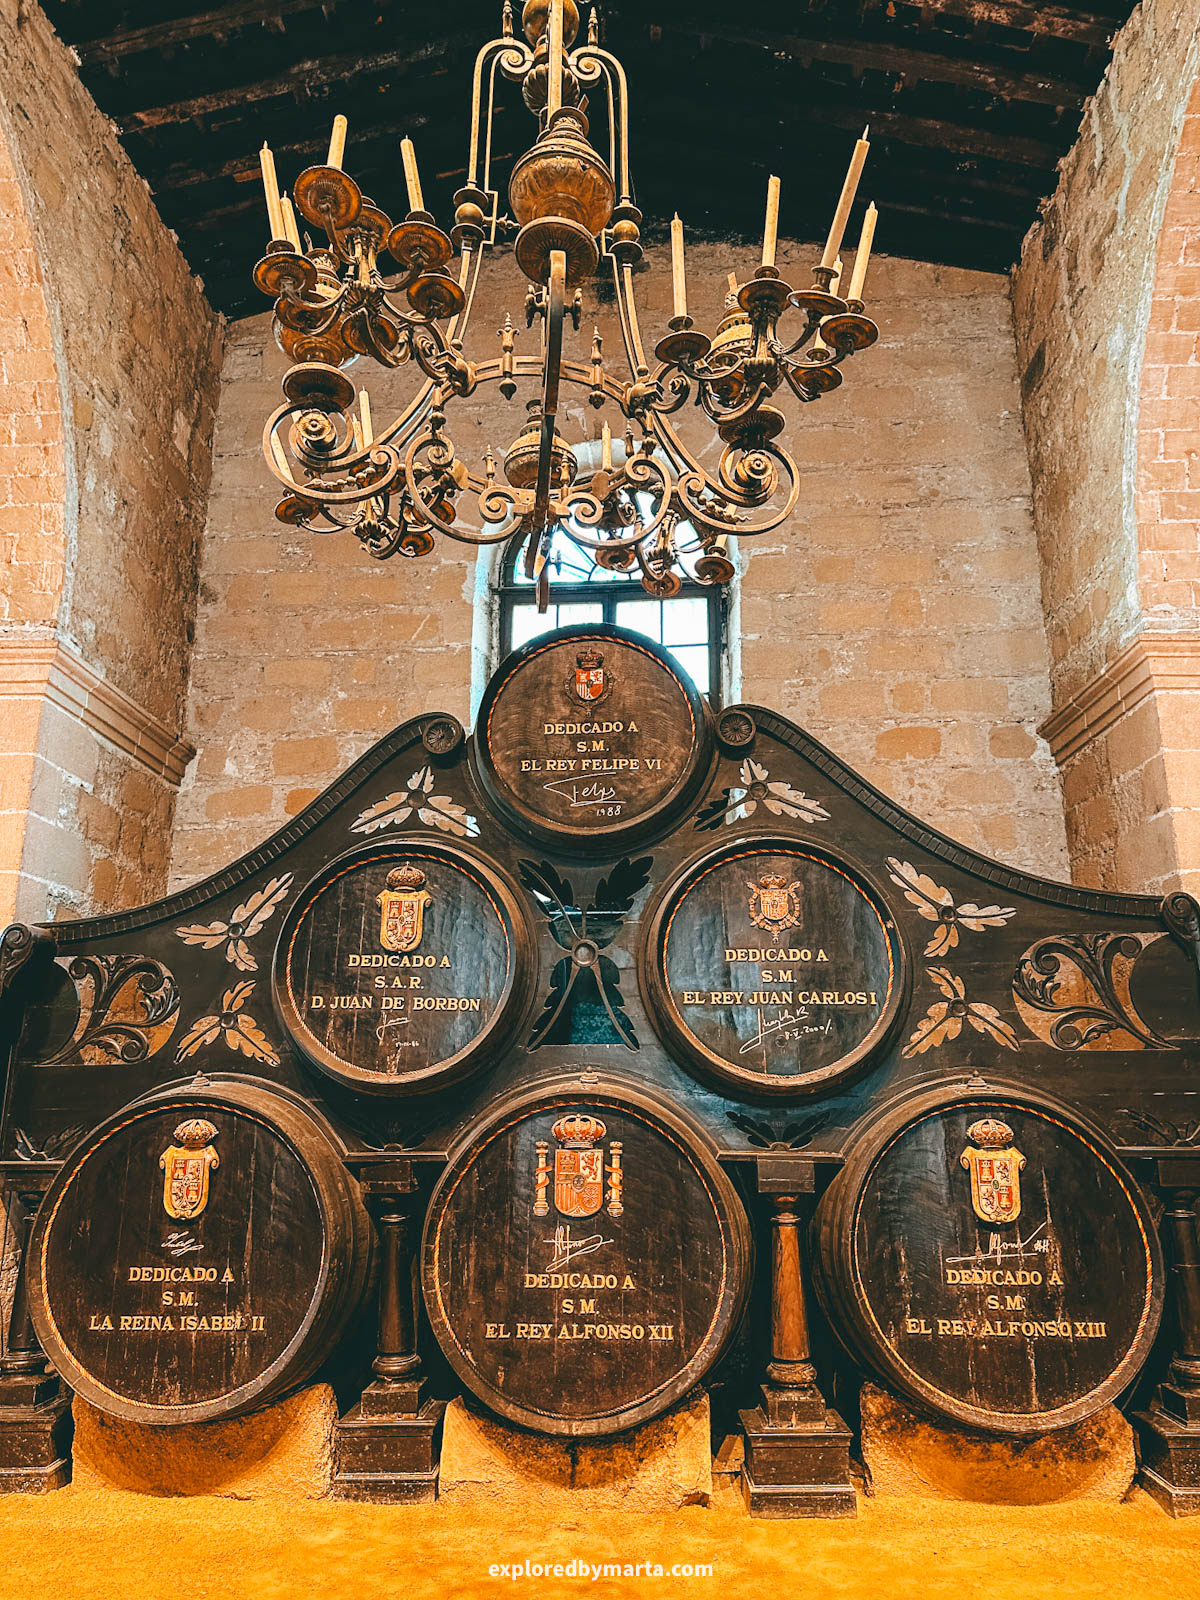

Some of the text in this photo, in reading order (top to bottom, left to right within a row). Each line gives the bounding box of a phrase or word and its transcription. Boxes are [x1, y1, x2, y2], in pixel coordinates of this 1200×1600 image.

[543, 721, 639, 735] DEDICADO A
[576, 740, 610, 753] S.M.
[521, 759, 662, 772] EL REY FELIPE VI
[348, 954, 451, 968] DEDICADO A
[724, 949, 829, 963] DEDICADO A
[761, 970, 797, 983] S.M.
[311, 996, 481, 1011] D. JUAN DE BORBON
[682, 992, 705, 1005] EL
[710, 992, 744, 1005] REY
[748, 992, 793, 1005] JUAN
[798, 992, 866, 1005] CARLOS
[128, 1267, 235, 1282] DEDICADO A
[946, 1269, 1064, 1286] DEDICADO A
[524, 1274, 635, 1290] DEDICADO A
[89, 1316, 265, 1331] LA REINA ISABEL II
[906, 1318, 1107, 1338] EL REY ALFONSO XIII
[485, 1323, 674, 1340] EL REY ALFONSO XII
